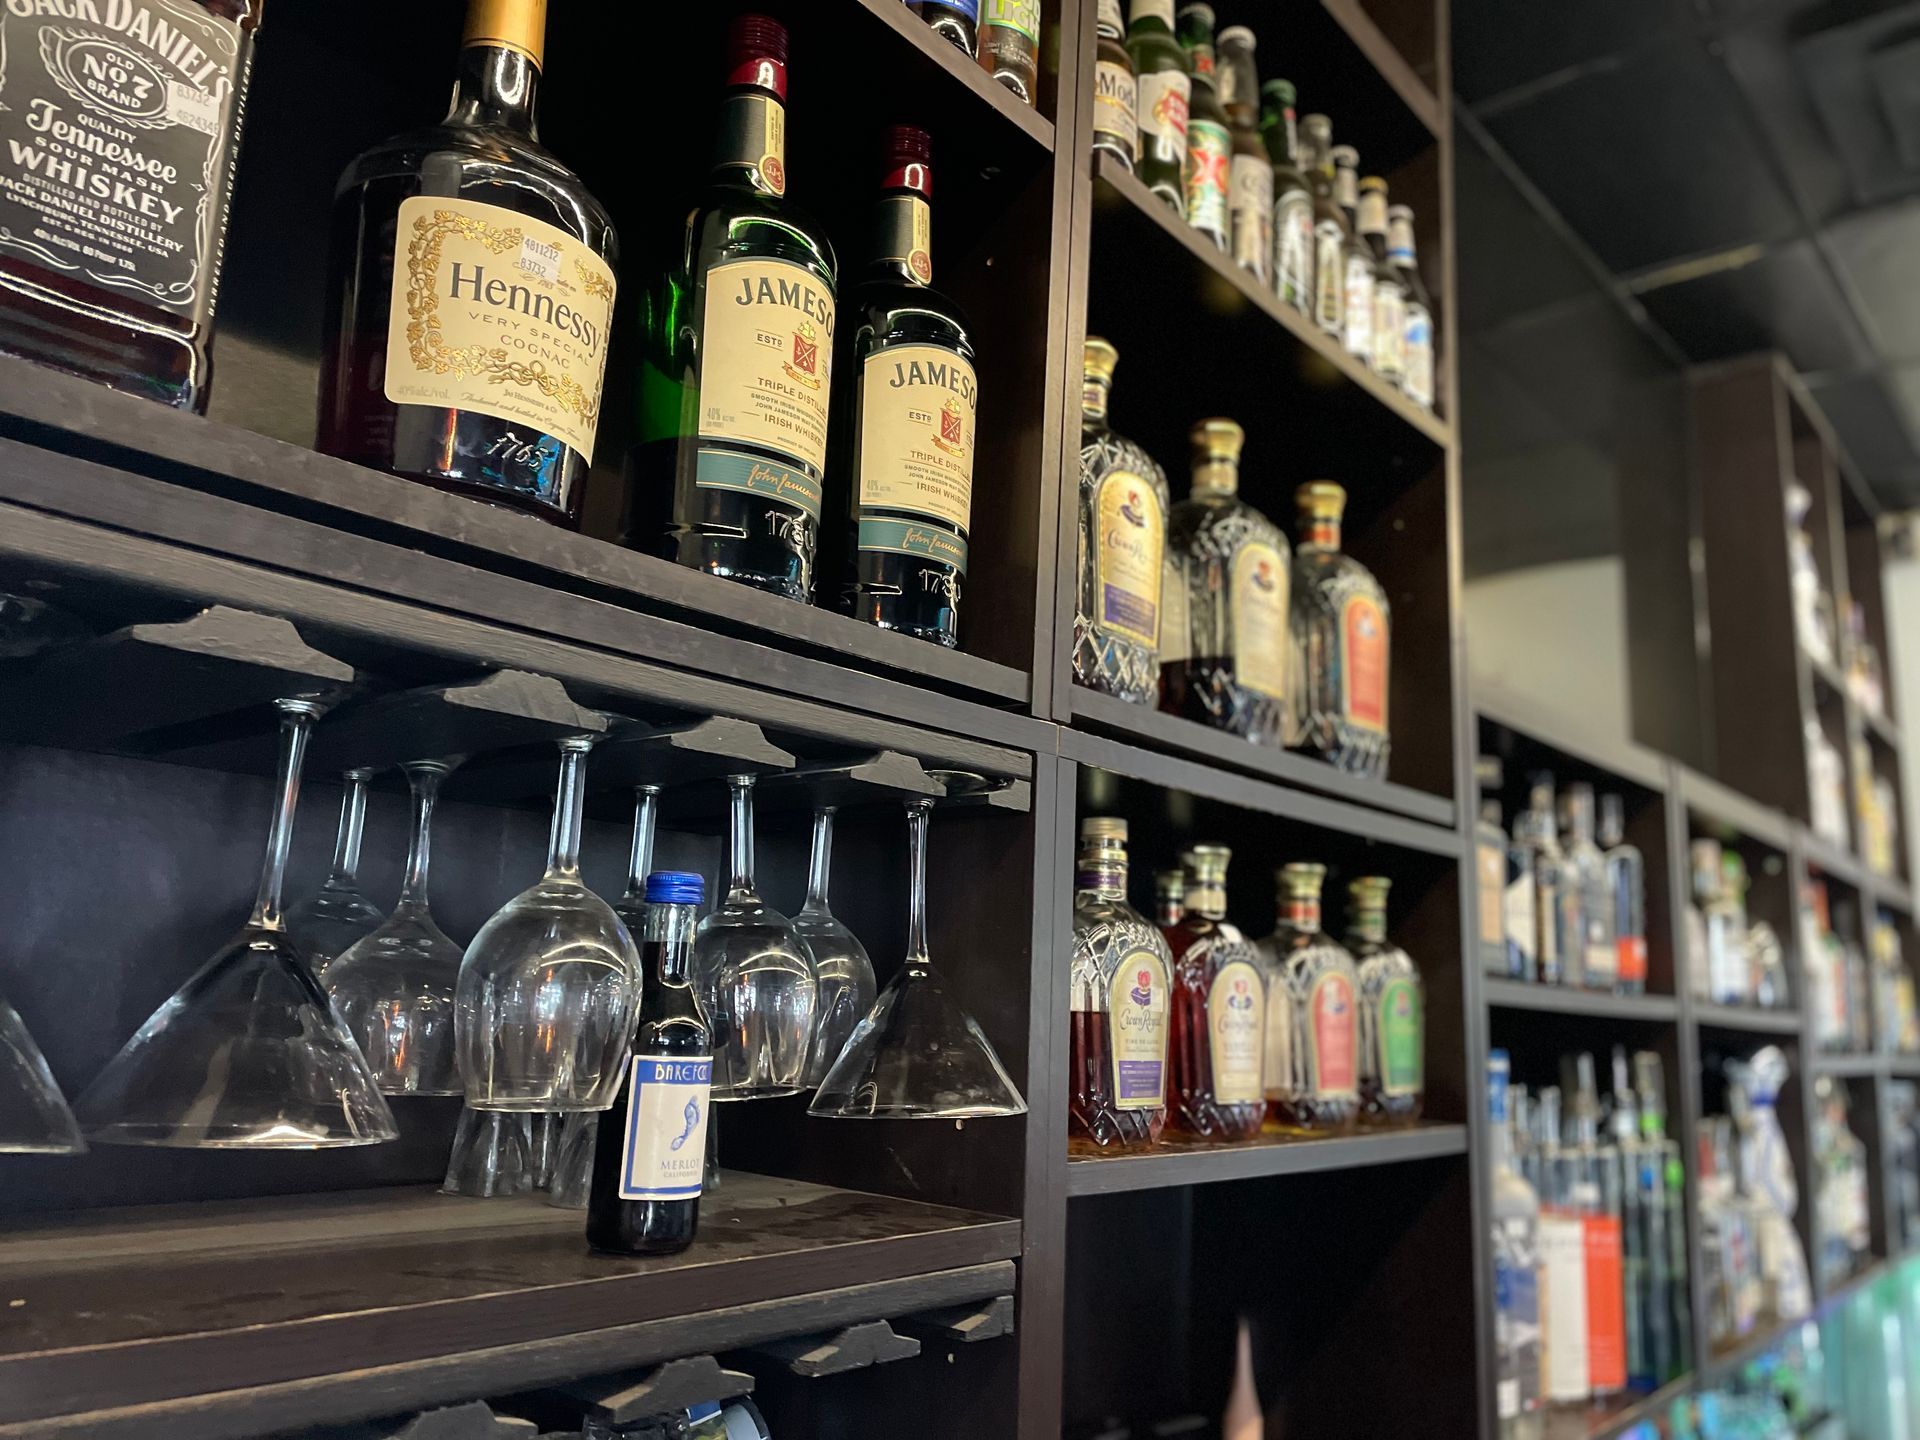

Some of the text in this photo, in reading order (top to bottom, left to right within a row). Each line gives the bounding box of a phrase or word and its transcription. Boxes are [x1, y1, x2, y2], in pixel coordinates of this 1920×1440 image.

[106, 52, 135, 70] OLD
[87, 78, 142, 109] BRAND
[77, 113, 136, 144] QUALITY
[26, 98, 177, 185] Tennessee
[34, 136, 164, 194] SOUR MASH
[8, 139, 184, 225] WHISKEY
[208, 237, 226, 317] BARRELED
[219, 203, 231, 235] AND
[225, 160, 238, 201] AGED
[233, 57, 252, 141] DISTILLERY
[22, 173, 163, 233] DISTILLED AND BOTTLED BY
[40, 191, 97, 221] DANIEL
[100, 213, 184, 253] DISTILLERY
[147, 244, 169, 258] USA
[524, 238, 560, 263] 4811212
[520, 256, 548, 278] 83732
[449, 262, 602, 358] Hennessy
[736, 277, 833, 338] JAMESO
[468, 311, 590, 366] VERY SPECIAL
[500, 334, 571, 370] COGNAC
[757, 377, 796, 397] TRIPLE
[889, 361, 975, 410] JAMESO
[750, 392, 778, 405] SMOOTH
[780, 400, 797, 411] IRISH
[755, 401, 774, 413] JOHN
[763, 413, 793, 431] IRISH
[904, 464, 929, 474] SMOOTH
[911, 450, 944, 466] TRIPLE
[748, 464, 779, 488] John
[908, 472, 924, 482] JOHN
[917, 482, 941, 496] IRISH
[660, 1158, 700, 1170] MERLOT
